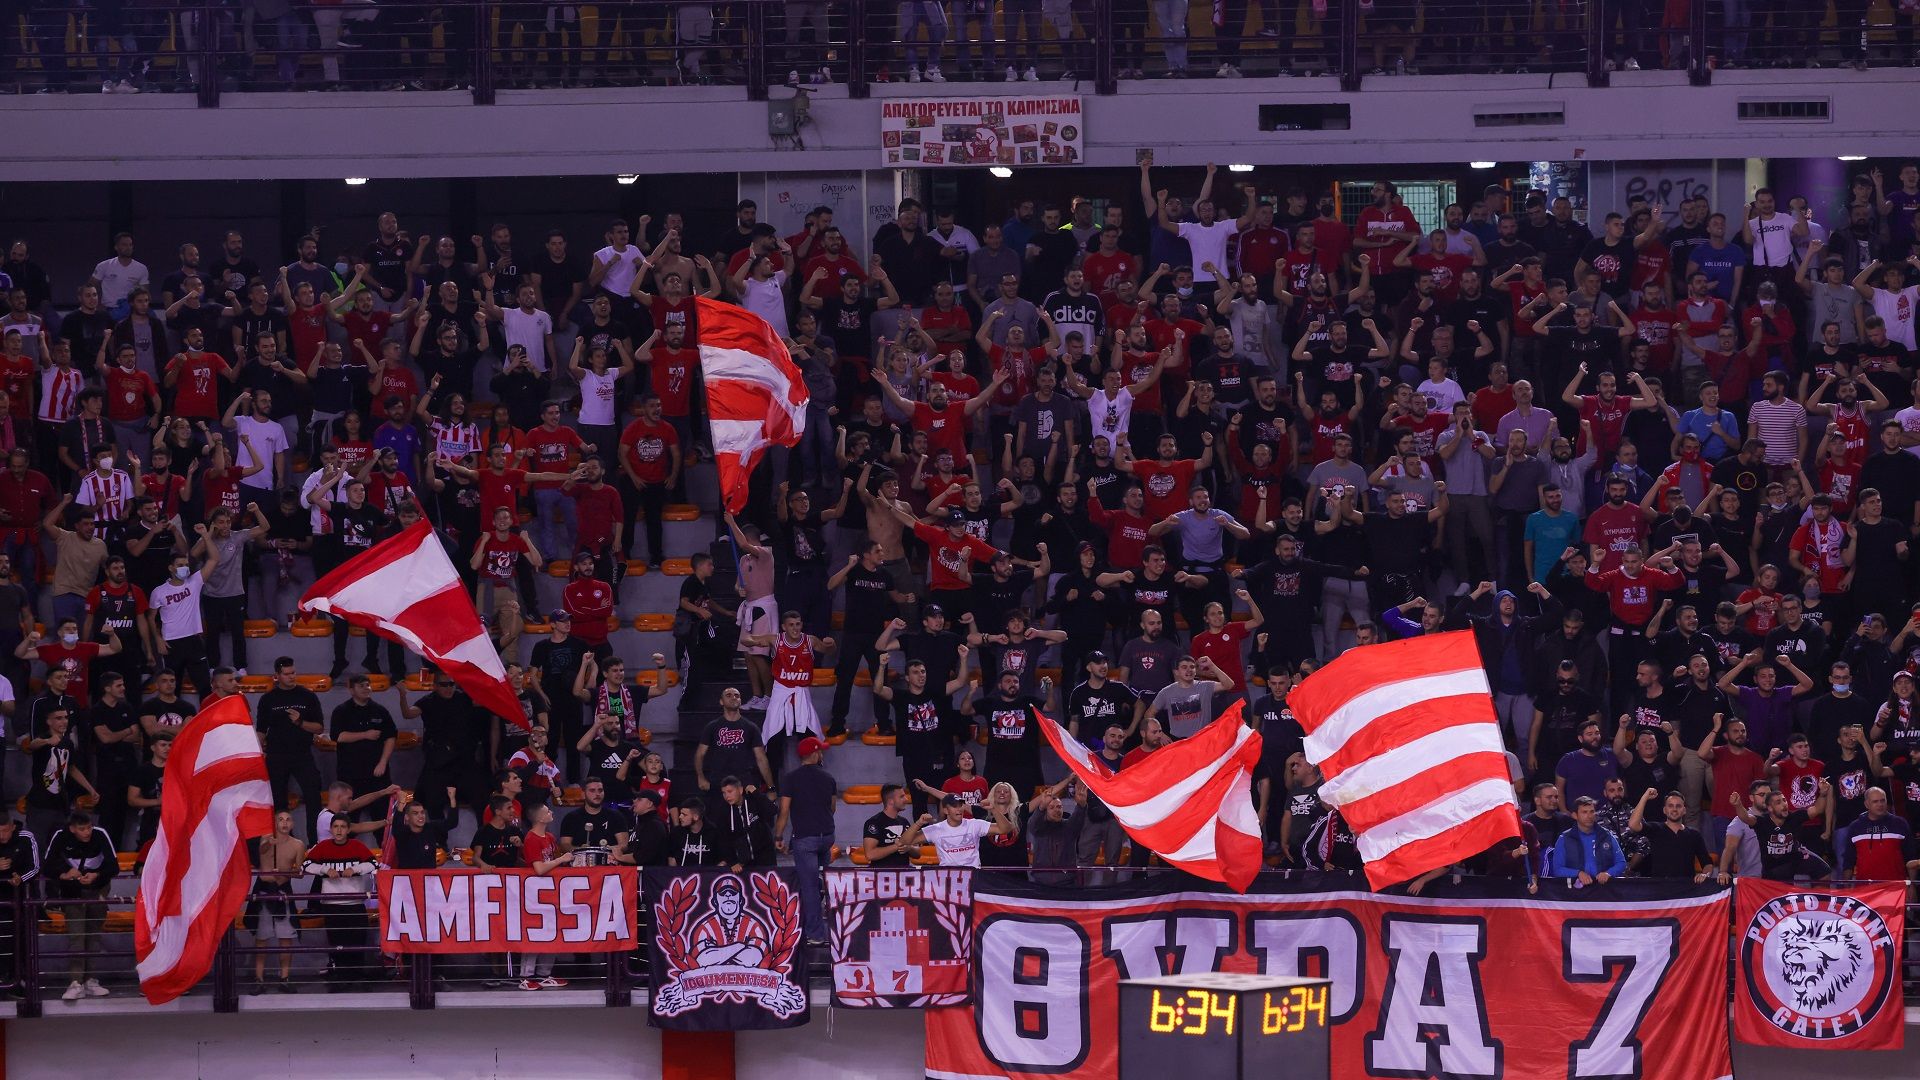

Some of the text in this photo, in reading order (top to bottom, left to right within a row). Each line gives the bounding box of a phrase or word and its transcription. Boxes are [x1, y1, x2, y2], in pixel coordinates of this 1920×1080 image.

[882, 100, 1081, 119] ΑΠΑΓΟΡΕΥΕΤΑΙ ΤΟ ΚΑΠΝΙΣΜΑ
[1757, 224, 1784, 233] adidas
[1704, 260, 1732, 268] HOLLISTER
[1054, 306, 1096, 322] dida
[383, 376, 407, 389] Oliver
[1847, 424, 1854, 434] 7
[1846, 439, 1863, 449] win
[115, 600, 123, 612] 7
[106, 616, 134, 629] bwin
[789, 655, 796, 666] 7
[780, 668, 809, 681] bwin
[825, 869, 972, 908] ΜΕΘΩΝΗ
[386, 873, 630, 943] AMFISSA
[1748, 896, 1891, 951] PORTO LEONE
[1563, 917, 1682, 1080] 7
[1150, 989, 1236, 1035] 6:34
[1261, 986, 1328, 1035] 6:34
[1772, 1007, 1863, 1037] GATE 7
